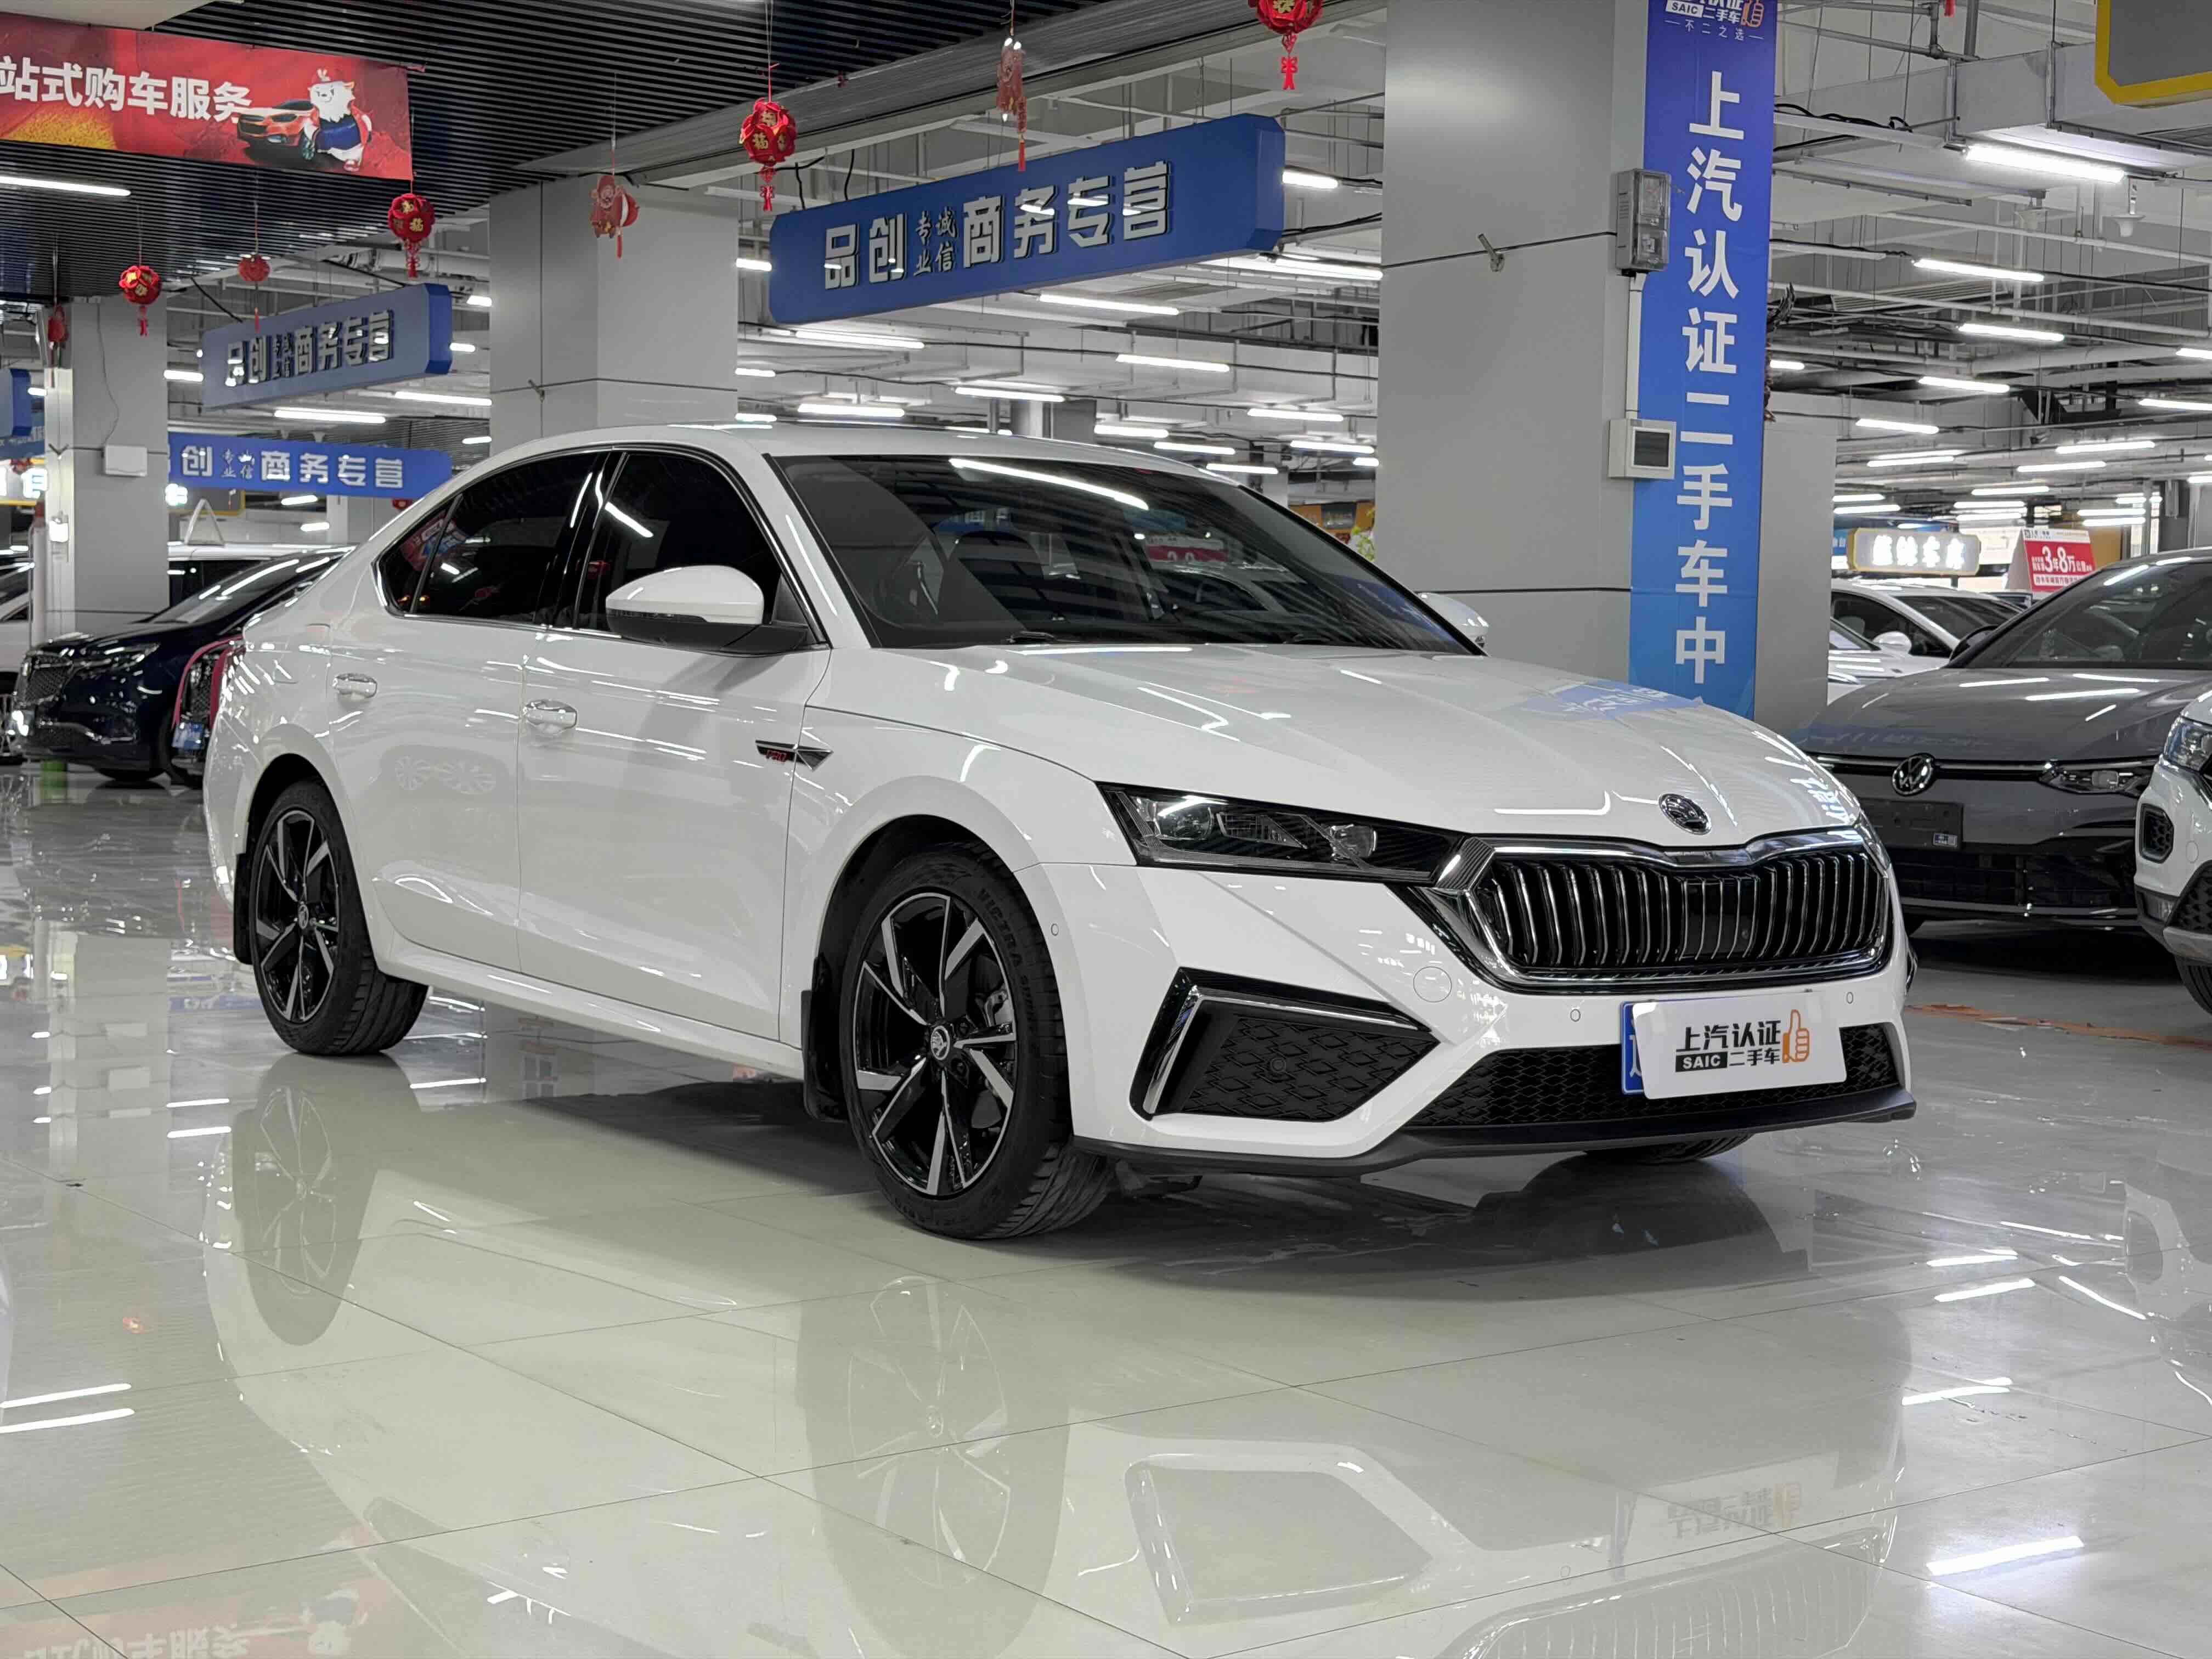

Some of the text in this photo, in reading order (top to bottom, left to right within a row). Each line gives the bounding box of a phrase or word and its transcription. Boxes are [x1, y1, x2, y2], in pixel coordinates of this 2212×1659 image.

[1671, 2, 1699, 14] SAIC
[1702, 7, 1741, 24] 二手车
[1685, 19, 1745, 41] 不二之选
[0, 55, 252, 123] 站式购车服务
[824, 214, 907, 290] 品创
[963, 161, 1169, 268] 商务专营
[224, 335, 268, 387] 品创
[295, 308, 391, 376] 商务专营
[261, 450, 404, 489] 商务专营
[1676, 1020, 1781, 1052] 上汽认证
[1683, 1048, 1781, 1070] SAIC 二手车
